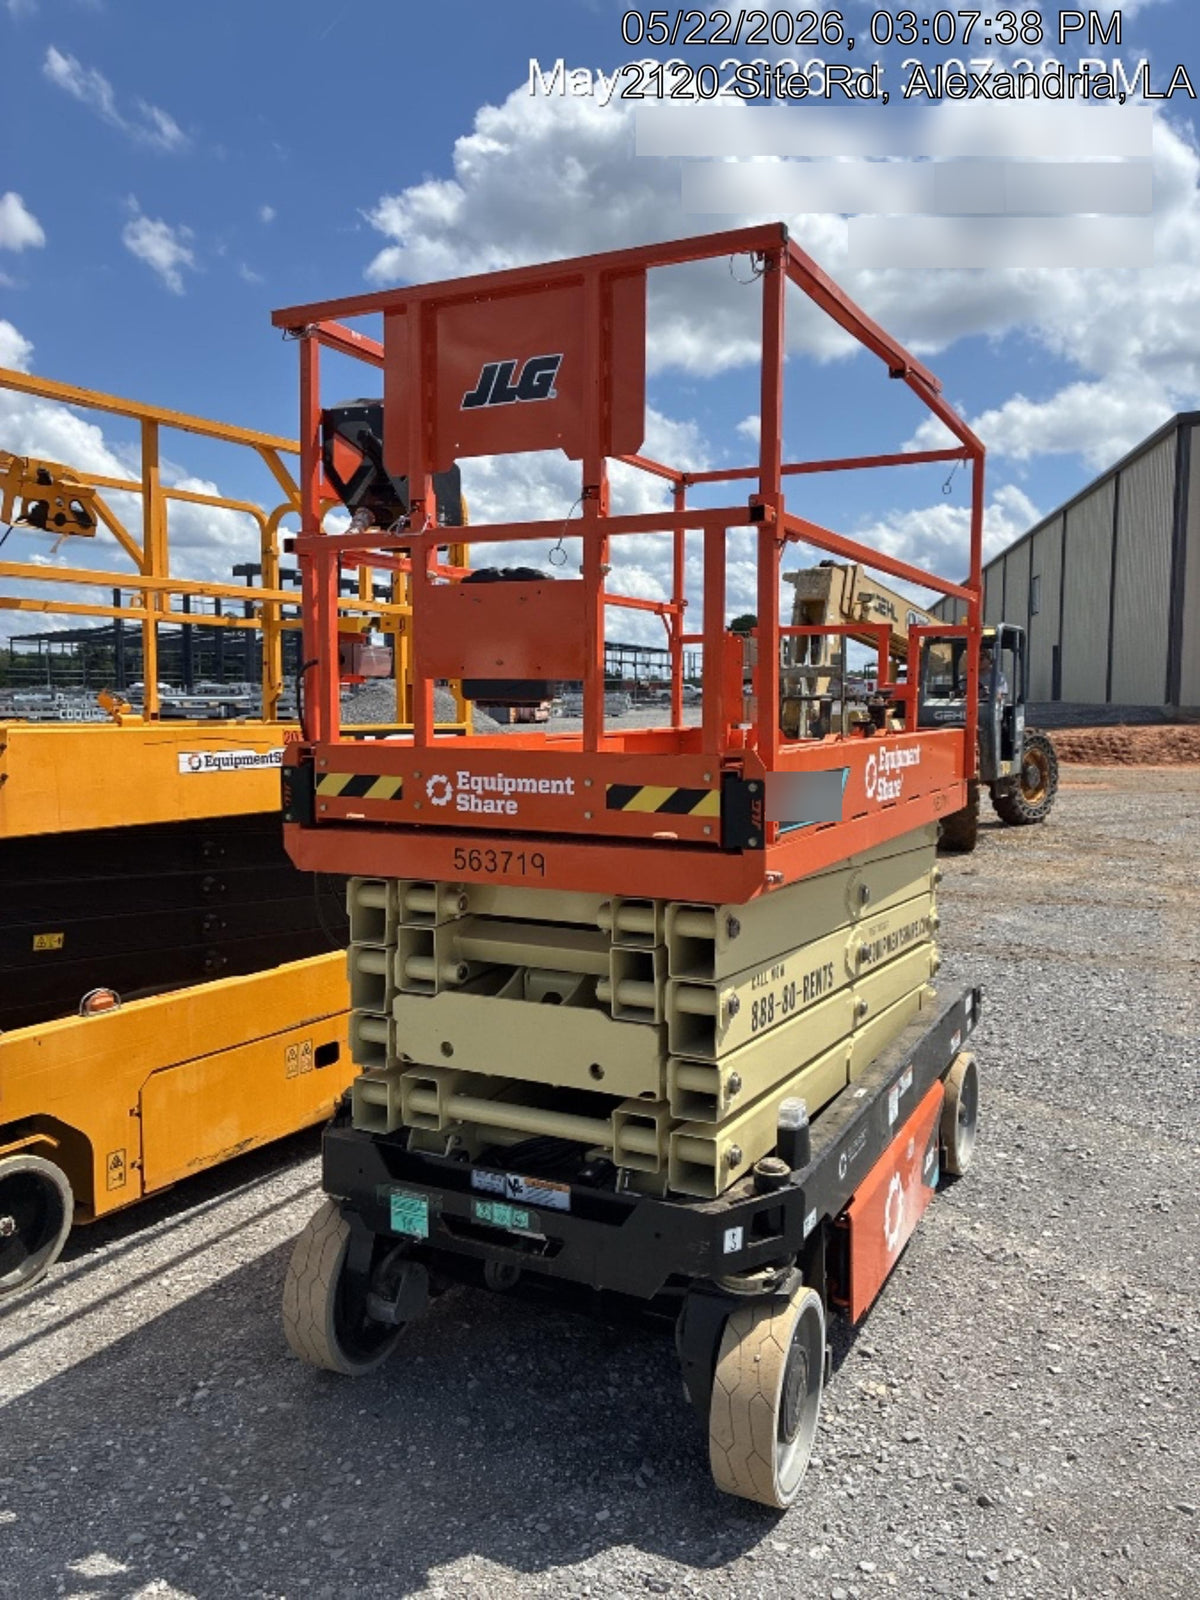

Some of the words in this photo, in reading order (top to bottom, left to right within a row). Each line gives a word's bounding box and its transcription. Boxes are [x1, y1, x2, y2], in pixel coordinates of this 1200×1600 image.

[460, 353, 564, 411] JLG
[204, 751, 283, 769] EquipmentS
[878, 744, 922, 775] Equipment
[456, 771, 575, 796] Equipment
[456, 793, 519, 815] Share
[454, 847, 546, 877] 563719
[751, 970, 769, 991] CALL
